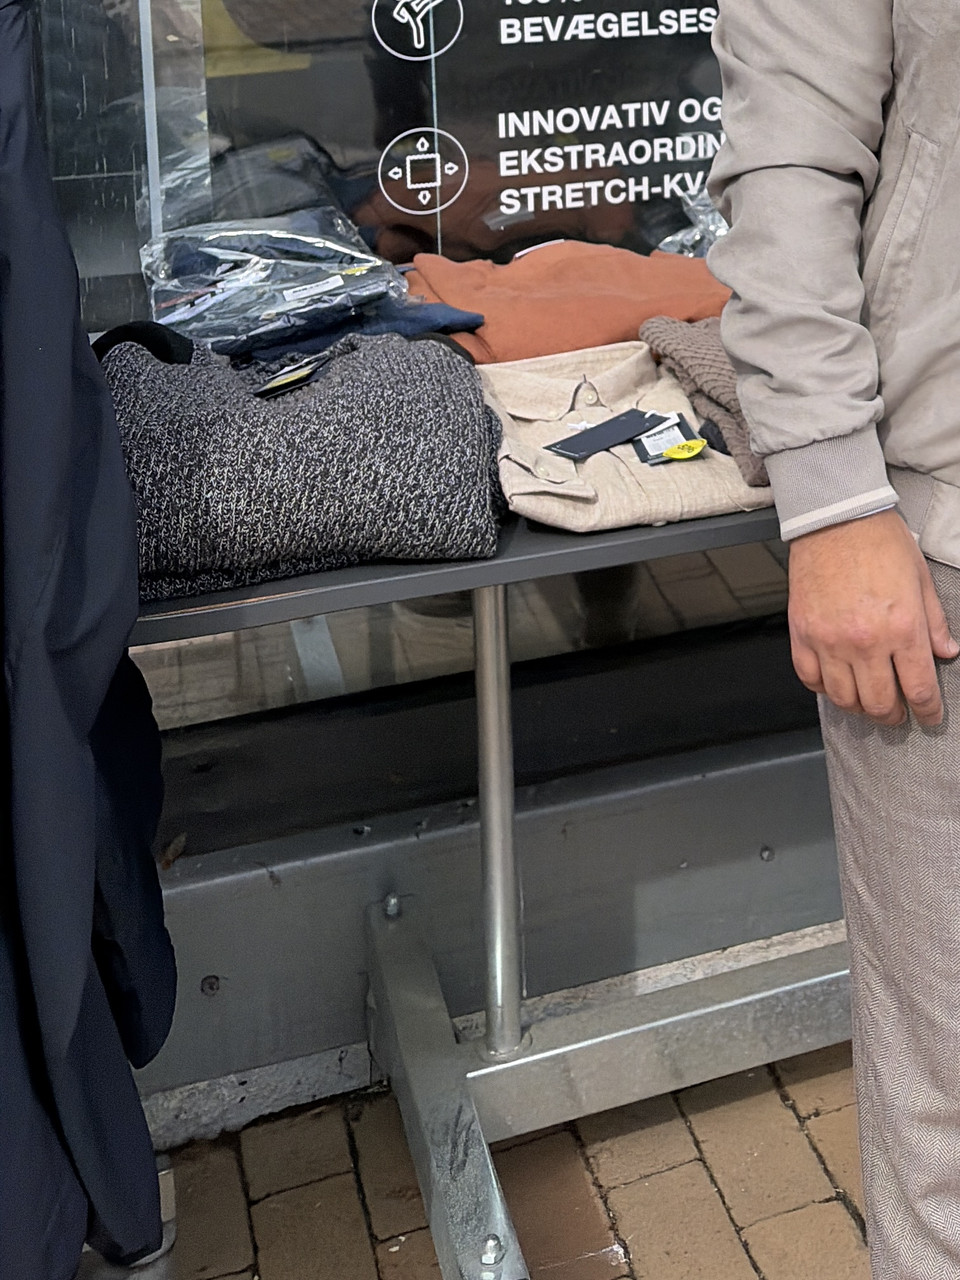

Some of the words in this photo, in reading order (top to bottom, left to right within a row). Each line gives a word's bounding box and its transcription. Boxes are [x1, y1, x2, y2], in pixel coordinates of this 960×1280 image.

[500, 7, 718, 45] BEVÆGELSES
[498, 100, 671, 138] INNOVATIV
[678, 96, 722, 123] OG
[499, 132, 727, 177] EKSTRAORDIN
[500, 171, 704, 214] STRETCH-KV
